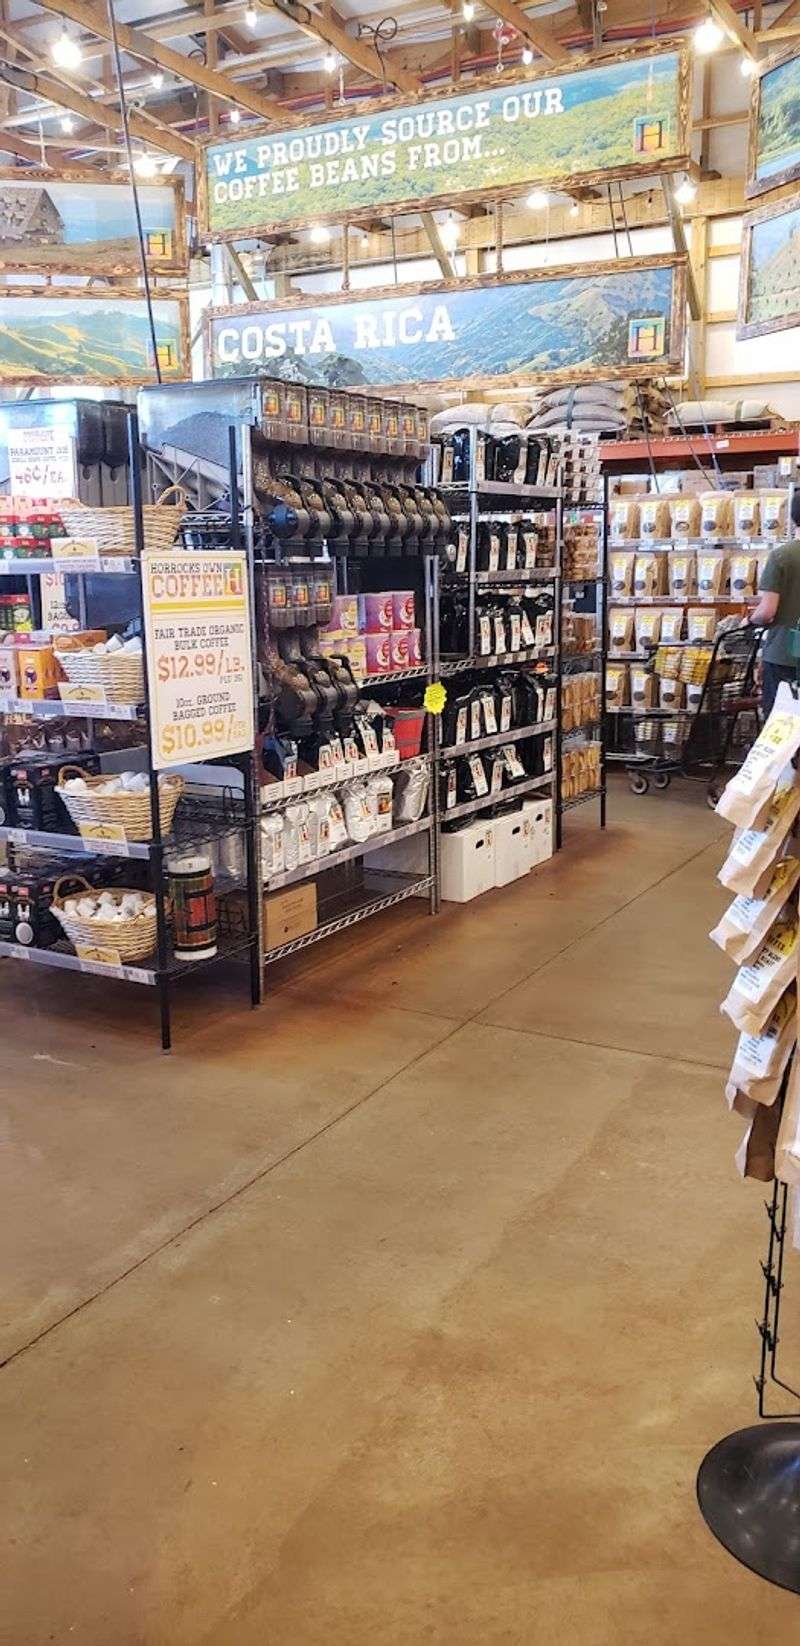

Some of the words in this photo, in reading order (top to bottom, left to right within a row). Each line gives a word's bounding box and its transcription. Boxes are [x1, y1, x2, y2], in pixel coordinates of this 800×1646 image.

[212, 147, 248, 178] WE
[256, 125, 371, 172] PROUDLY
[382, 101, 492, 145] SOURCE
[502, 87, 565, 121] OUR
[639, 120, 663, 152] H
[213, 168, 299, 204] COFFEE
[309, 150, 397, 189] BEANS
[407, 135, 506, 170] FROM...
[216, 319, 337, 361] COSTA
[353, 303, 458, 350] RICA
[634, 324, 658, 352] H
[150, 562, 201, 574] HORROCKS
[202, 562, 223, 573] OWN
[151, 574, 224, 598] COFFEE
[154, 628, 175, 639] FAIR
[178, 626, 207, 638] TRADE
[209, 623, 244, 635] ORGANIC
[174, 640, 198, 651] BULK
[199, 637, 229, 649] COFFEE
[197, 692, 230, 706] GROUND
[173, 707, 207, 721] BAGGED
[208, 703, 237, 716] COFFEE
